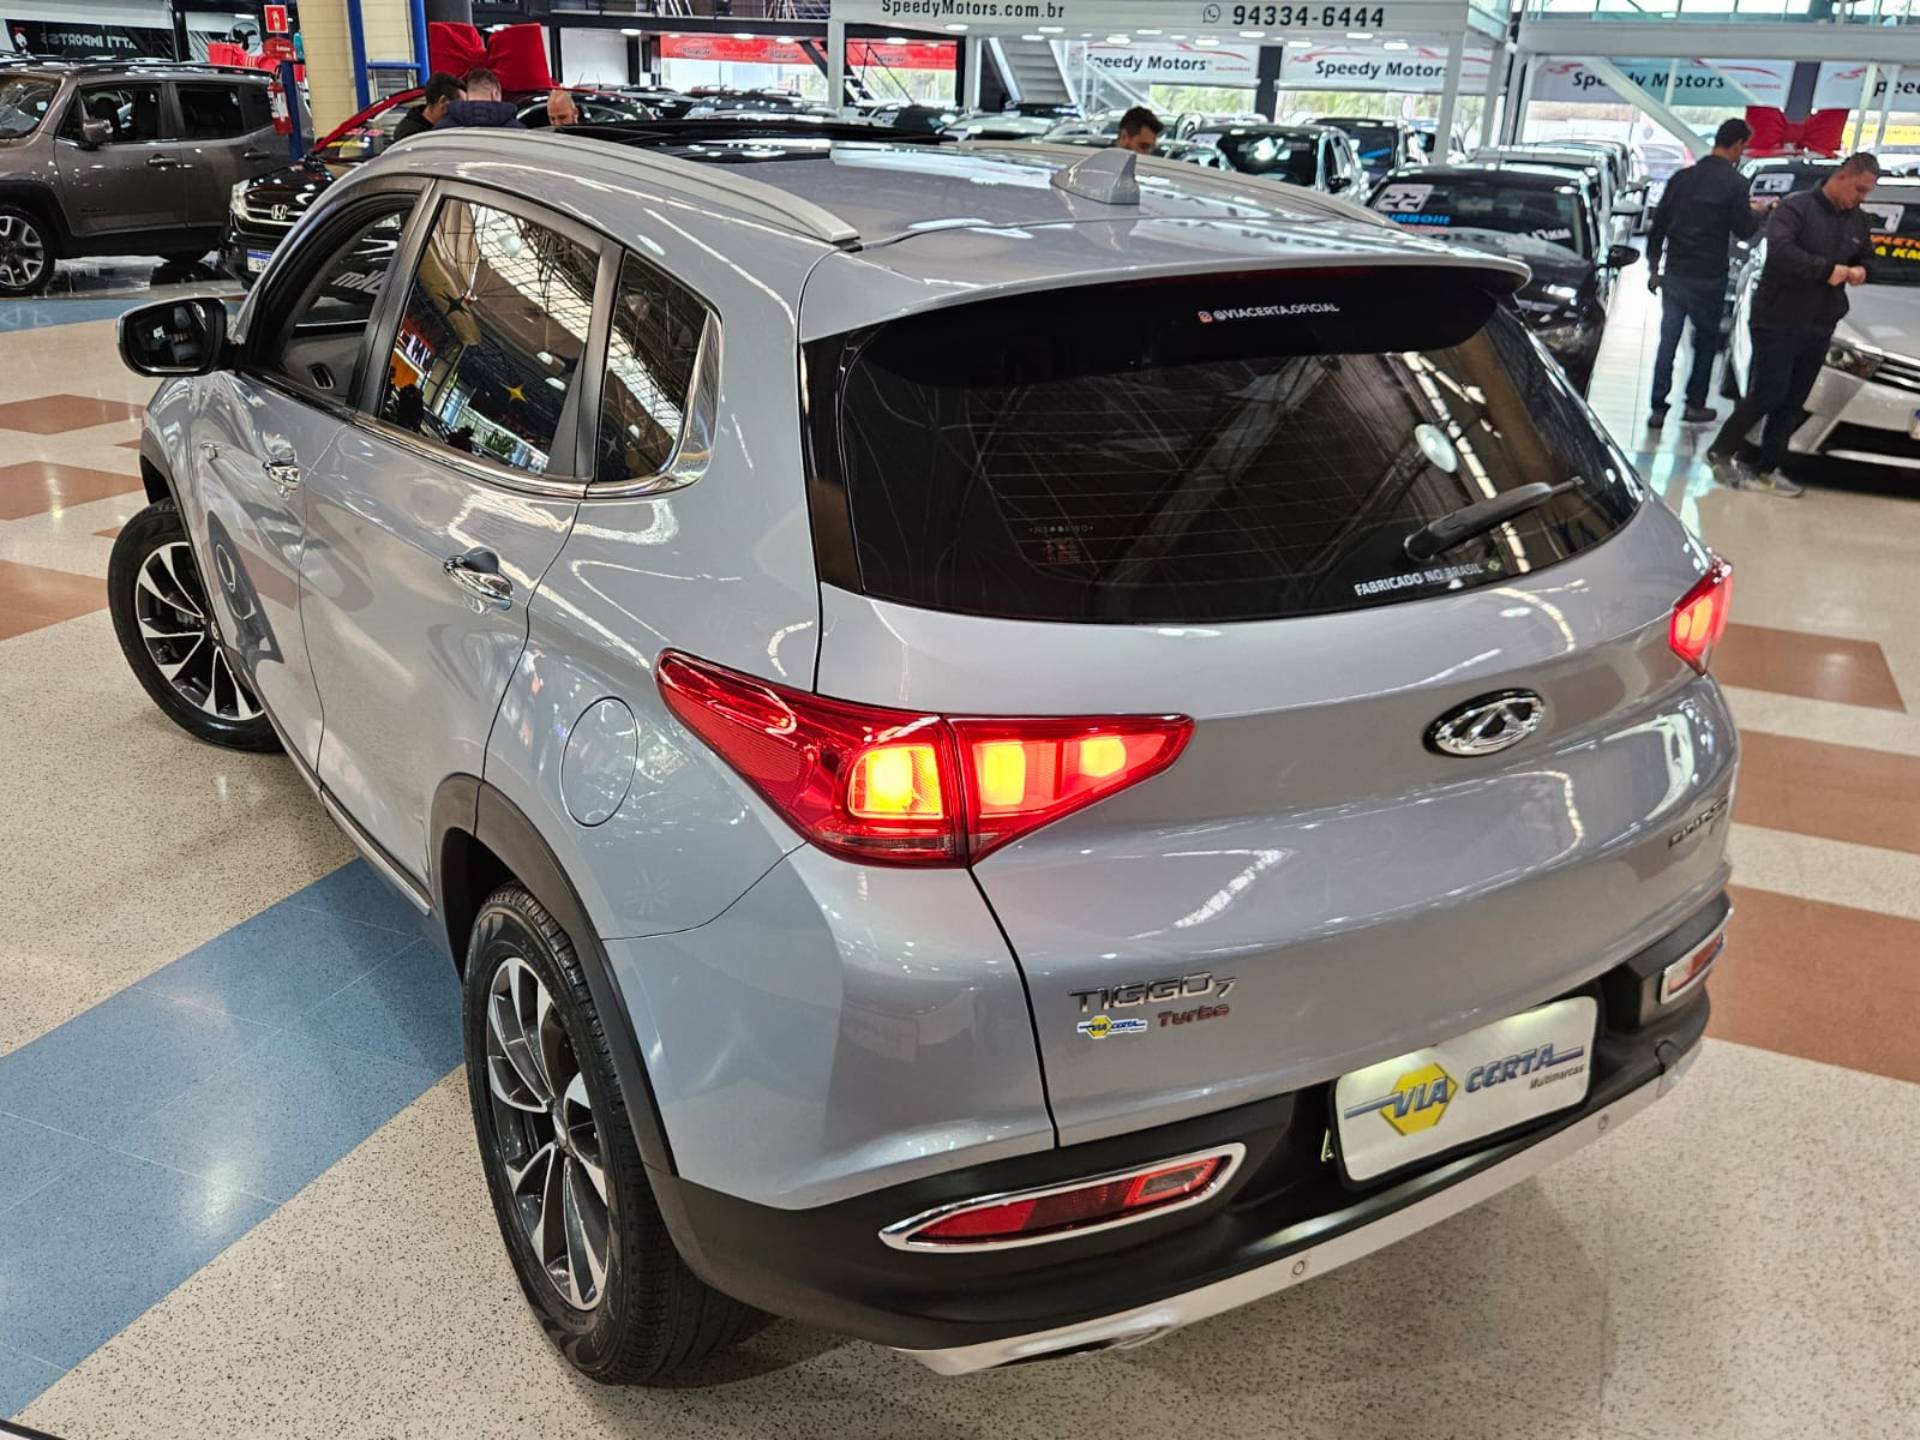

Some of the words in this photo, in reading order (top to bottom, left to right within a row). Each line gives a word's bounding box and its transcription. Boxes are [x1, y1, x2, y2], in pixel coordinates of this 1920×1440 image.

[882, 0, 1065, 18] SpeedyMotors.com.br
[1232, 5, 1385, 28] 94334-6444
[1087, 53, 1143, 72] eedy
[1147, 55, 1207, 71] Motors
[1315, 60, 1382, 79] Speedy
[1354, 572, 1423, 596] FABRICADO
[1424, 569, 1444, 583] NO
[1444, 562, 1485, 578] BRASIL
[1157, 1003, 1231, 1028] Turbo
[1391, 1075, 1452, 1118] VIA
[1464, 1043, 1555, 1094] CERTA
